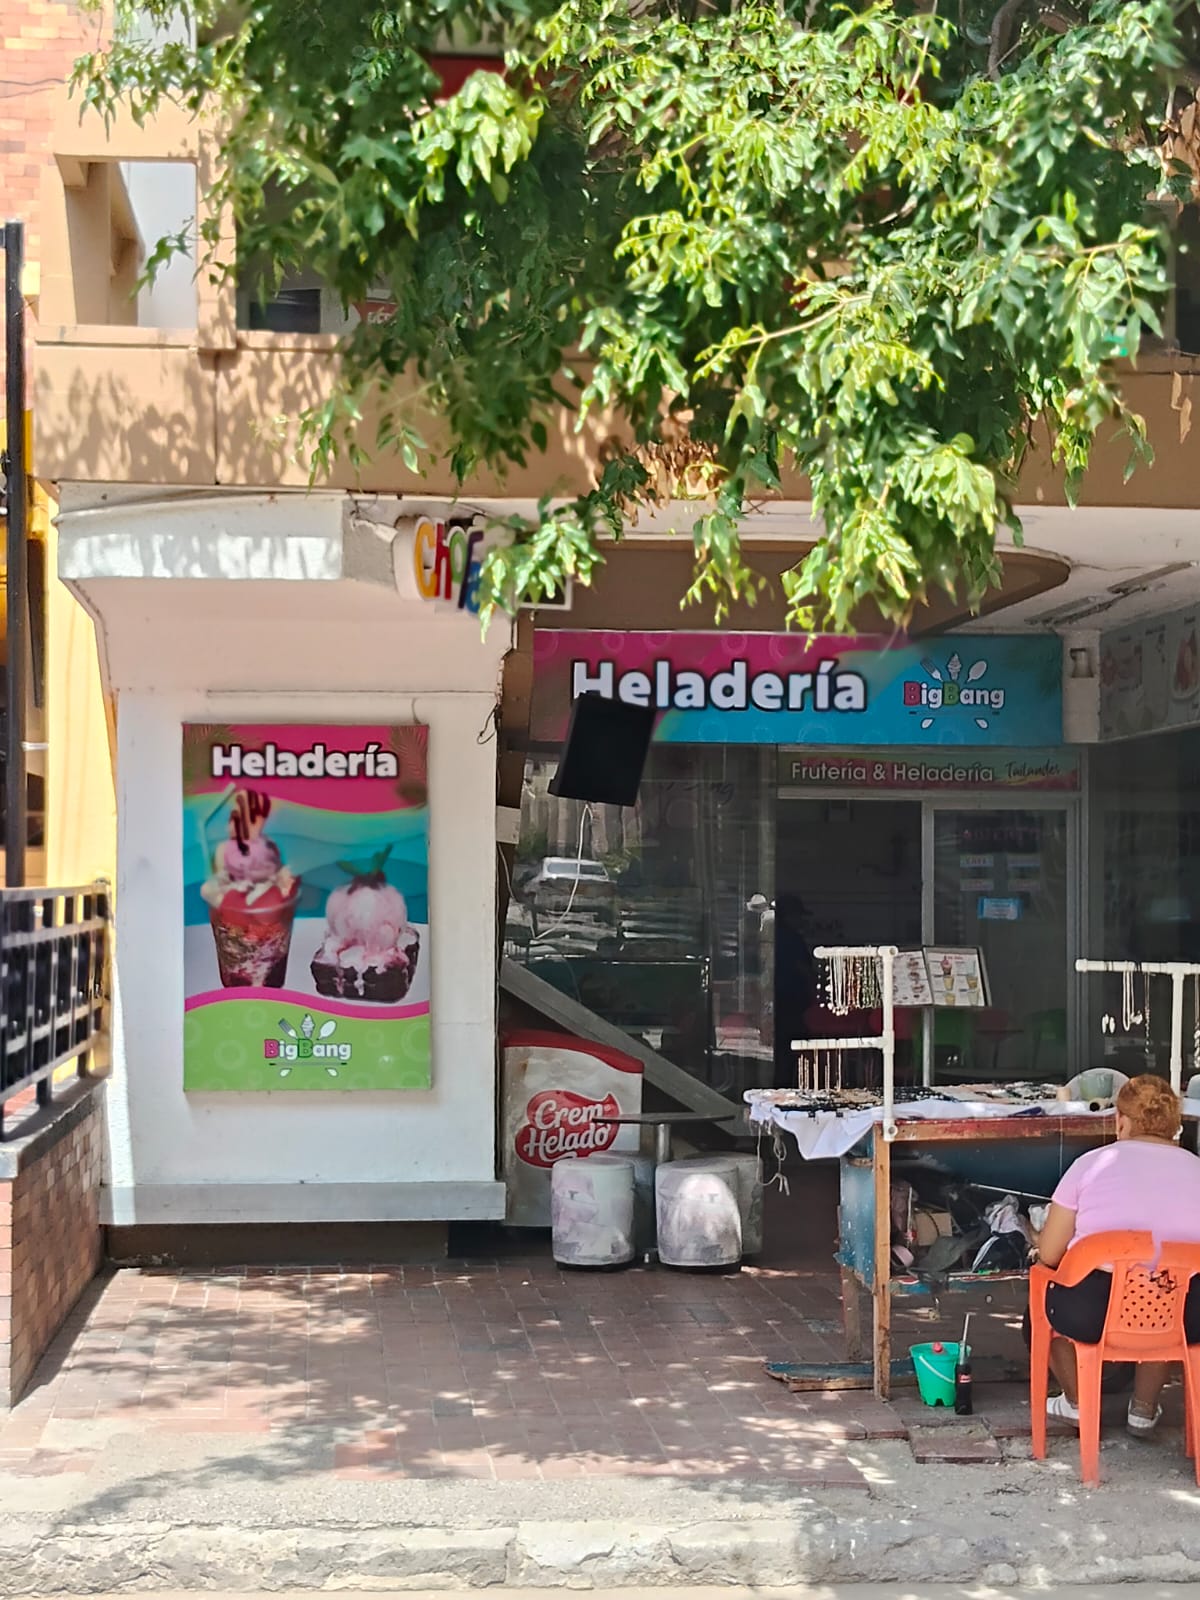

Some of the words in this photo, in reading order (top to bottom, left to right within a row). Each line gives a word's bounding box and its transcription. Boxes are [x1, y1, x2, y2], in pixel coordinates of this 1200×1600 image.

[572, 659, 866, 711] Heladería
[904, 681, 1005, 709] BigBang
[212, 744, 398, 779] Heladería
[791, 762, 866, 781] Frutería
[873, 764, 886, 781] &
[893, 762, 993, 782] Heladería
[264, 1038, 352, 1061] BigBang
[534, 1099, 604, 1130] Crem
[523, 1124, 612, 1160] Helado
